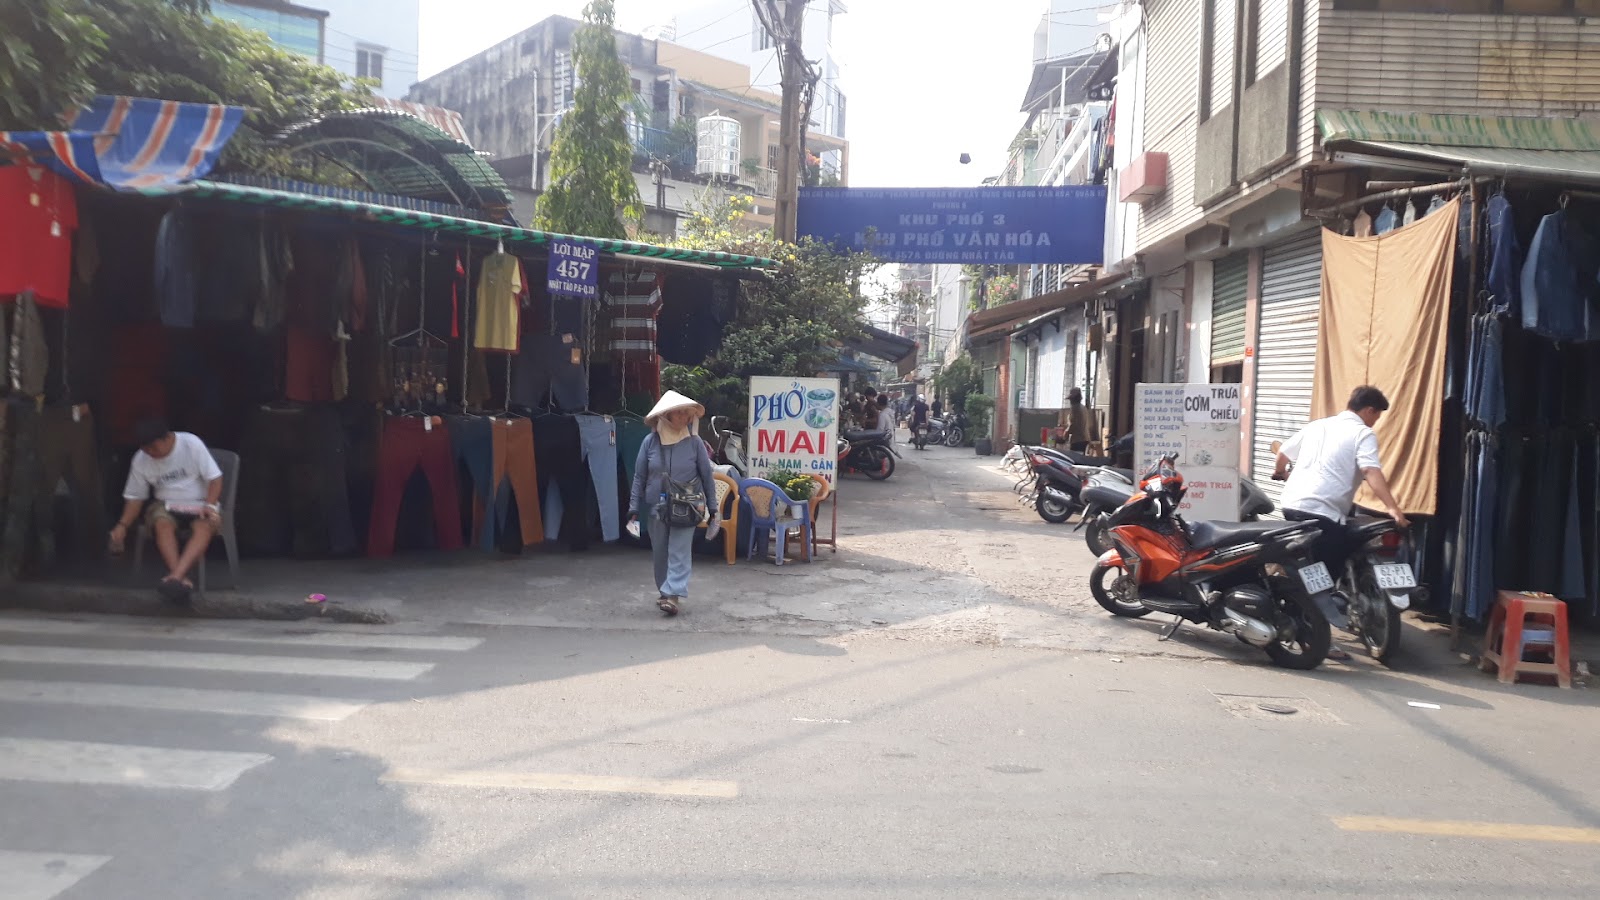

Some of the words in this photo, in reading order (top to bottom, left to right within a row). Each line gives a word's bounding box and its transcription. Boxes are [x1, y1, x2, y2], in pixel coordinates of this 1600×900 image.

[900, 214, 938, 225] KHU
[945, 211, 985, 225] PHỐ
[993, 214, 1005, 225] 3
[903, 229, 945, 246] PHỐ
[953, 231, 1000, 246] VĂN
[553, 243, 571, 258] LỢI
[572, 245, 595, 260] MẬP
[556, 260, 590, 280] 457
[1210, 386, 1239, 399] TRƯA
[752, 381, 807, 427] PHỞ
[1184, 394, 1210, 412] CƠM
[757, 429, 827, 454] MAI
